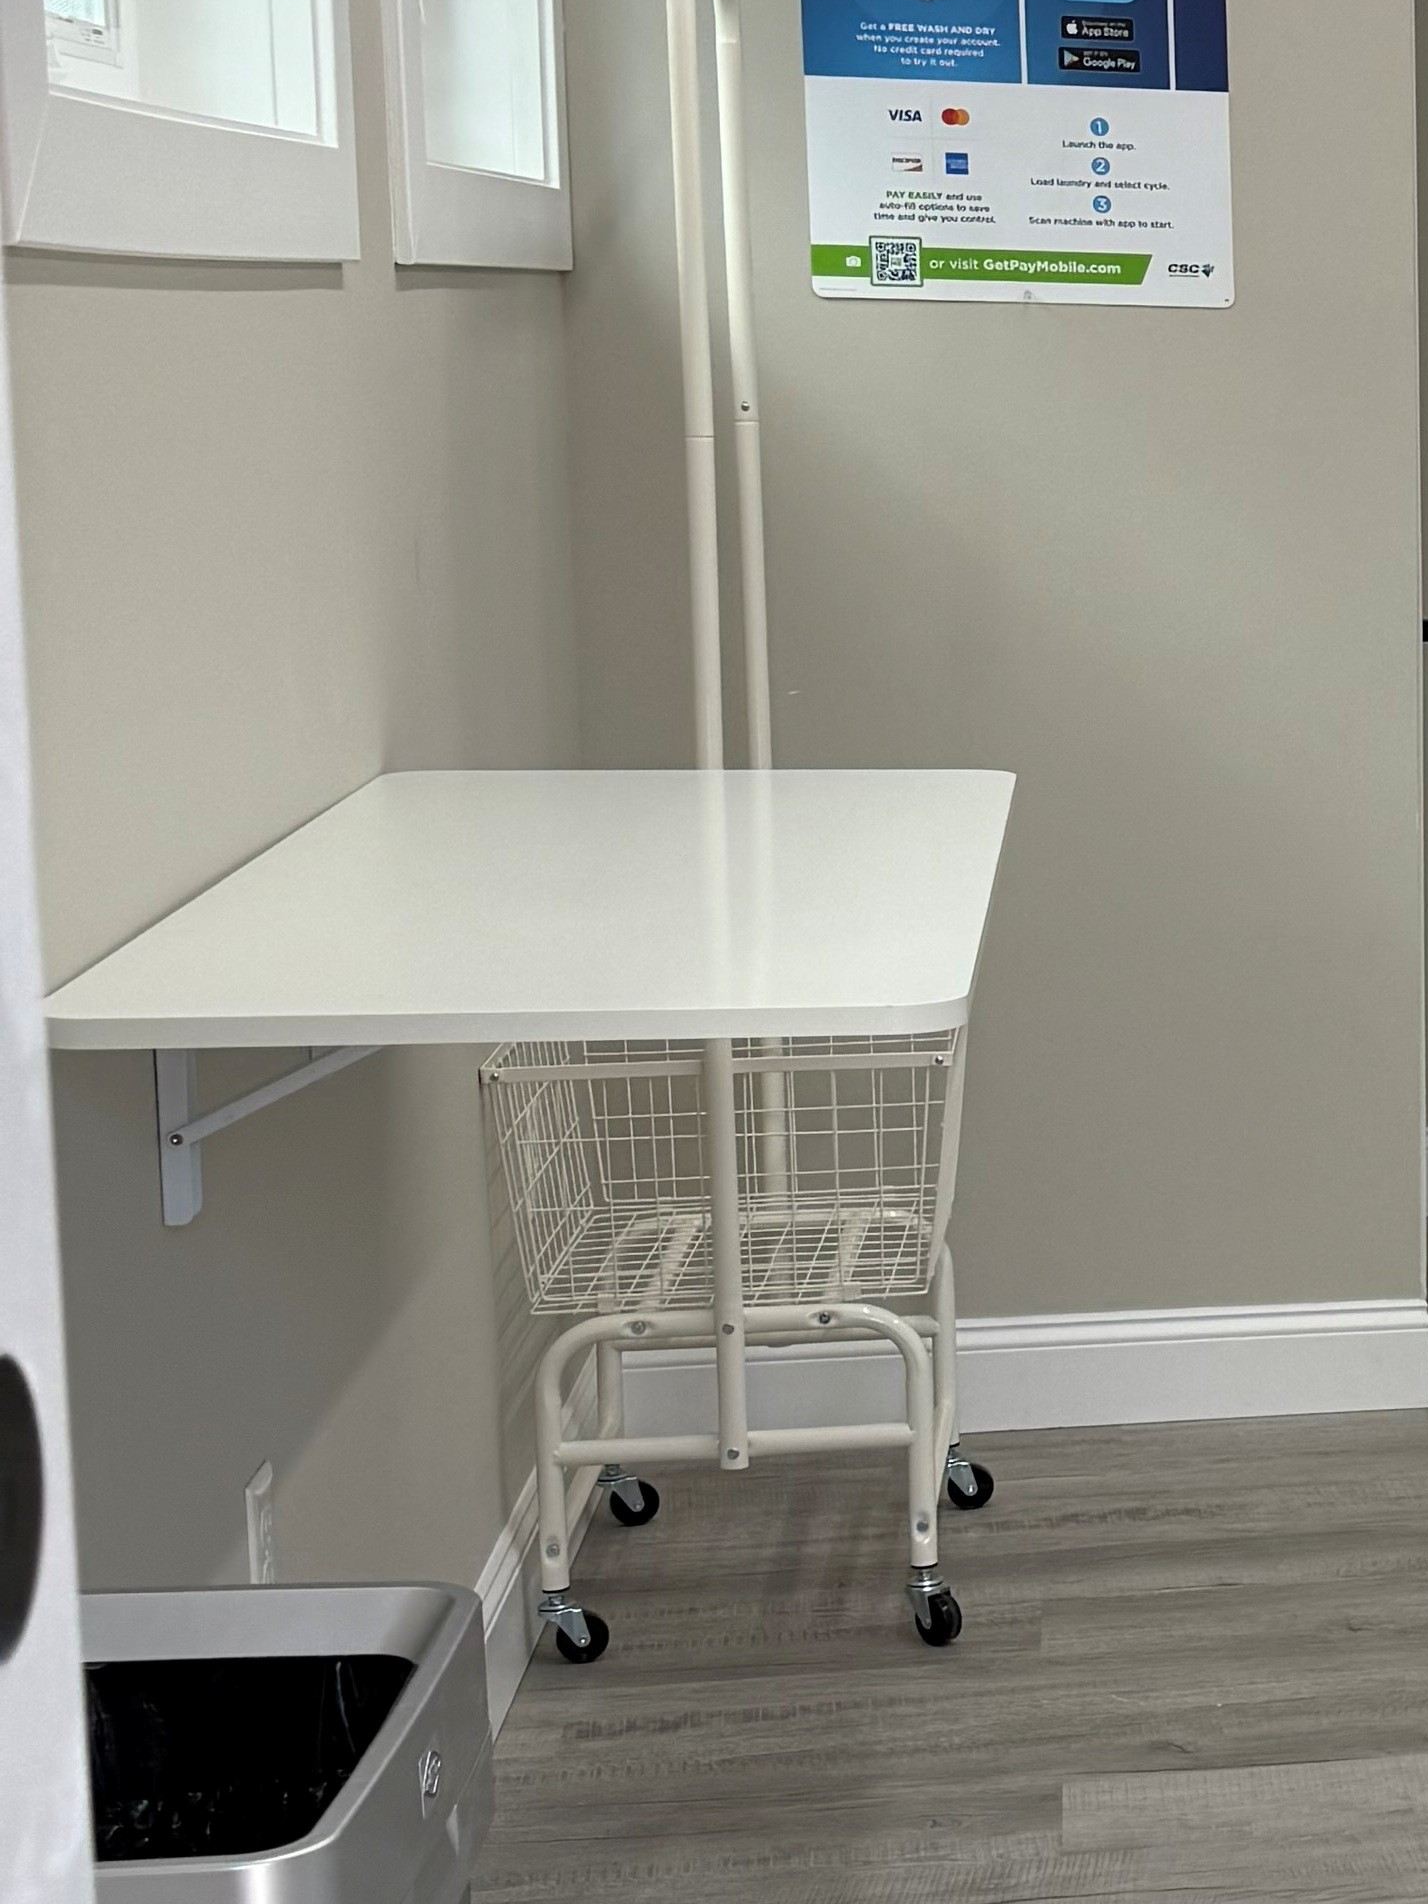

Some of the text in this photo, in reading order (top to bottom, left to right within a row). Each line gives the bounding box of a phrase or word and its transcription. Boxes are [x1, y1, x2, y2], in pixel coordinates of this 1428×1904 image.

[860, 21, 877, 31] Get
[888, 23, 915, 32] FREE
[917, 24, 949, 33] WASH
[950, 25, 972, 34] AND
[975, 27, 996, 35] DRY
[1081, 27, 1129, 37] App Store
[855, 34, 882, 42] when
[884, 35, 902, 43] you
[904, 36, 934, 44] create
[937, 38, 958, 46] your
[890, 46, 918, 55] credit
[920, 47, 942, 55] card
[943, 48, 984, 57] required
[900, 57, 912, 65] to
[913, 58, 927, 67] try
[1083, 56, 1136, 70] Google Play
[888, 109, 922, 122] VISA
[1095, 120, 1102, 133] 1
[1062, 139, 1096, 149] Launch
[1098, 141, 1114, 150] the
[1095, 159, 1106, 173] 2
[1030, 177, 1055, 186] Load
[1056, 178, 1092, 189] laundry
[1094, 180, 1112, 189] and
[1114, 180, 1142, 190] select
[886, 190, 906, 199] PAY
[908, 191, 943, 200] EASILY
[945, 193, 964, 201] and
[918, 203, 954, 212] options
[956, 204, 967, 212] to
[1096, 198, 1108, 211] 3
[873, 212, 895, 220] time
[897, 213, 916, 221] and
[917, 214, 938, 223] give
[940, 215, 958, 223] you
[1028, 216, 1052, 225] Scan
[1053, 217, 1093, 226] machine
[1095, 218, 1116, 227] with
[1117, 220, 1136, 229] app
[1137, 220, 1148, 228] to
[929, 256, 1122, 276] or visit GetPayMobile.com
[1167, 262, 1200, 275] CSC
